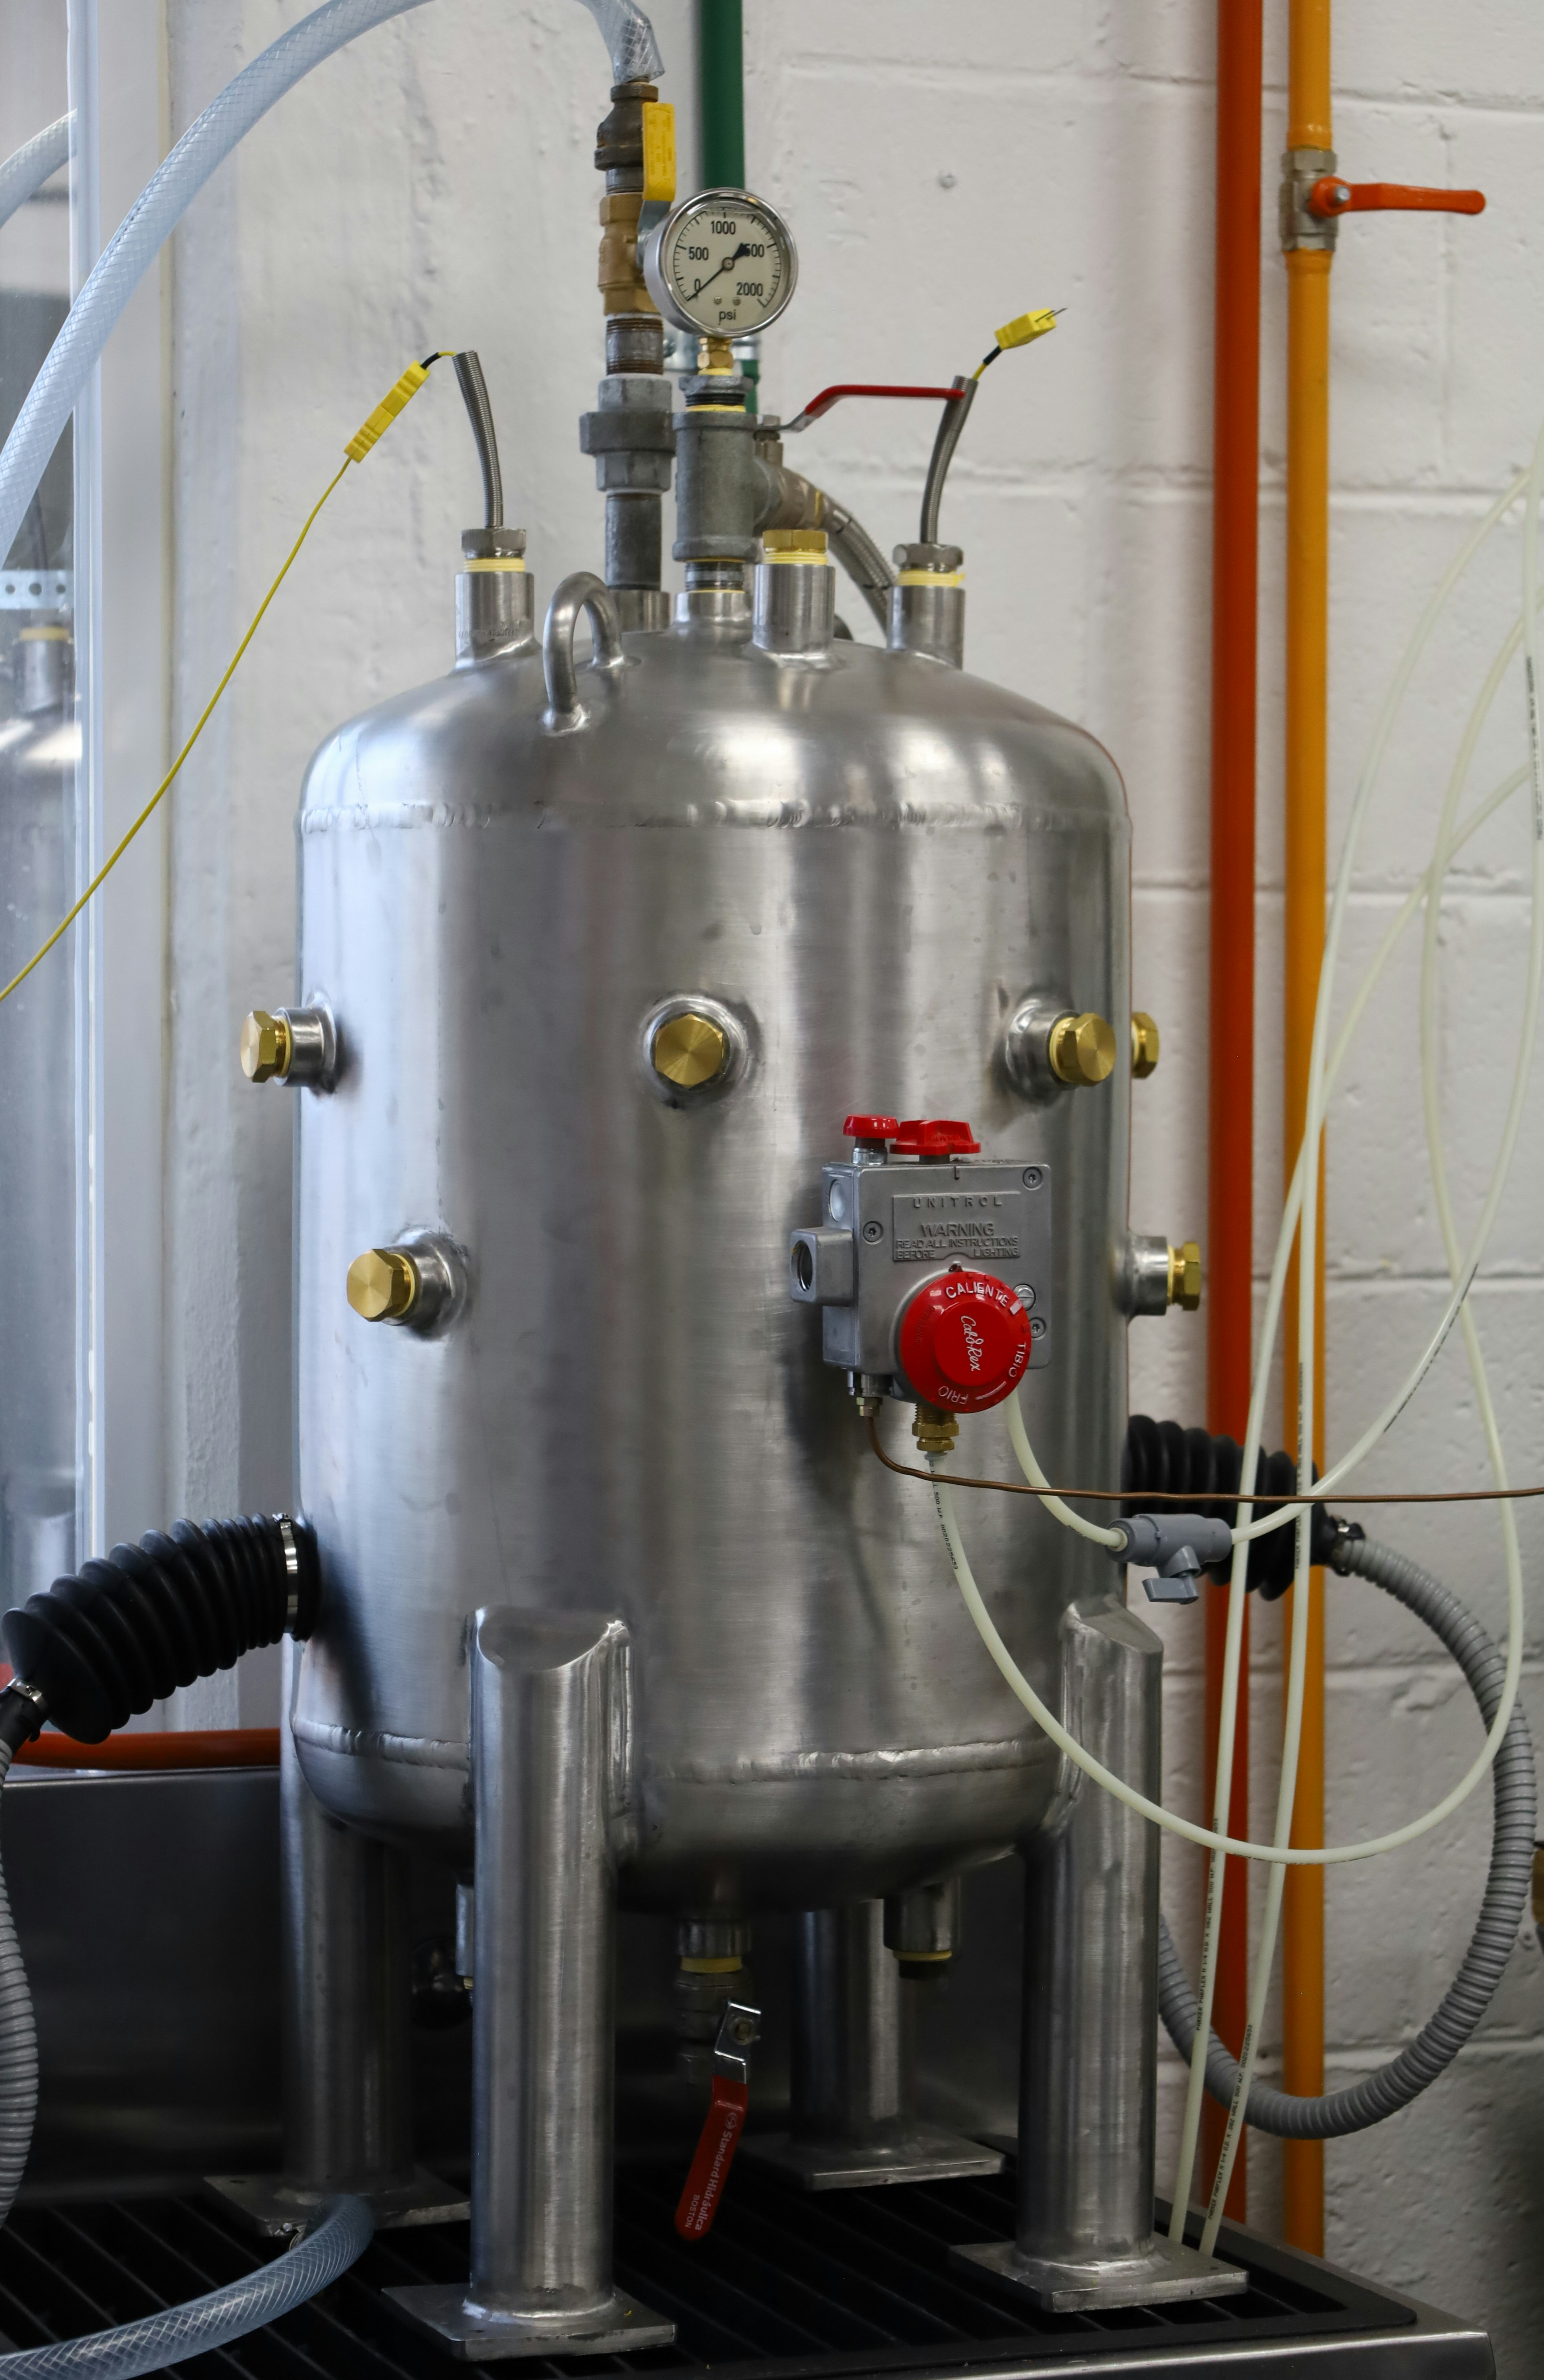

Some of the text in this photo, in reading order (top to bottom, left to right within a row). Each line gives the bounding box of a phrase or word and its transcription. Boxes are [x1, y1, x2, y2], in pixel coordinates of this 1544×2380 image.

[711, 220, 736, 235] 1000
[689, 247, 709, 260] 500
[742, 244, 764, 258] 500
[694, 279, 701, 294] 0
[736, 282, 763, 297] 2000
[718, 309, 736, 322] psi
[913, 1196, 1002, 1208] UNITROL
[920, 1222, 995, 1237] WARNING
[896, 1236, 1019, 1249] READ ALL INSTRUCTIONS
[896, 1248, 1019, 1259] BEFORE LIGHTING
[945, 1281, 1009, 1307] CALIENTE
[1008, 1342, 1026, 1378] TIBIO
[938, 1386, 969, 1405] FRIO
[941, 1524, 958, 1570] 0020225653
[1207, 2199, 1217, 2220] PARKER
[1212, 2171, 1223, 2197] PARFLEX
[1230, 2100, 1239, 2116] WALL
[1239, 2024, 1253, 2068] 0020225653
[694, 2130, 732, 2231] Standard Hidráulica
[685, 2194, 700, 2228] BOSTON
